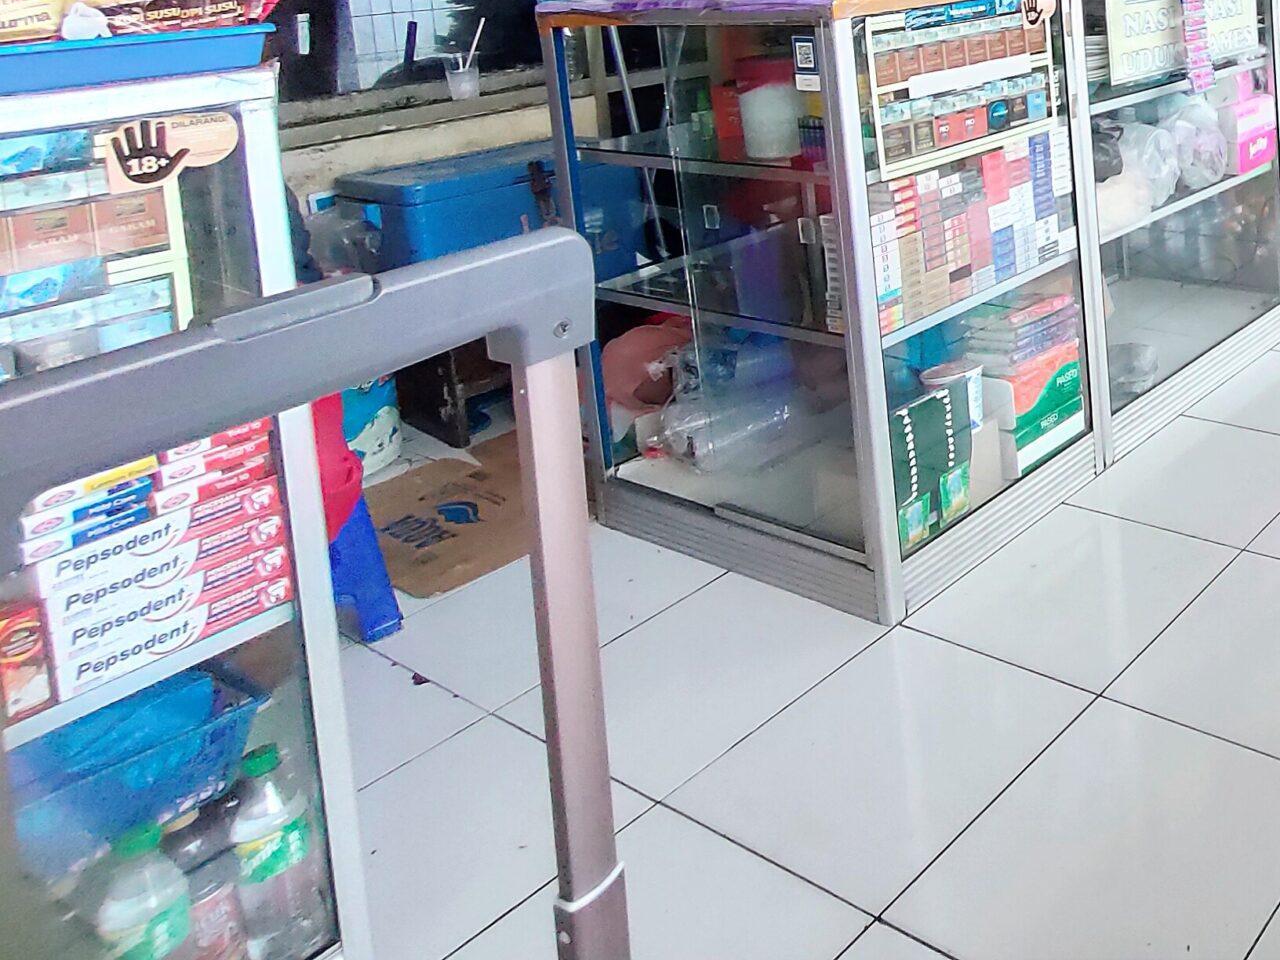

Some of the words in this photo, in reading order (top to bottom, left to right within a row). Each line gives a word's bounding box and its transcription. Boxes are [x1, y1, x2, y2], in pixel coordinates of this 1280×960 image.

[1122, 5, 1176, 38] NASI
[1208, 25, 1252, 57] AMES
[126, 155, 170, 176] 18+
[56, 523, 172, 578] Pepsodent
[65, 555, 180, 612] Pepsodent
[72, 587, 185, 646] Pepsodent
[76, 620, 190, 681] Pepsodent
